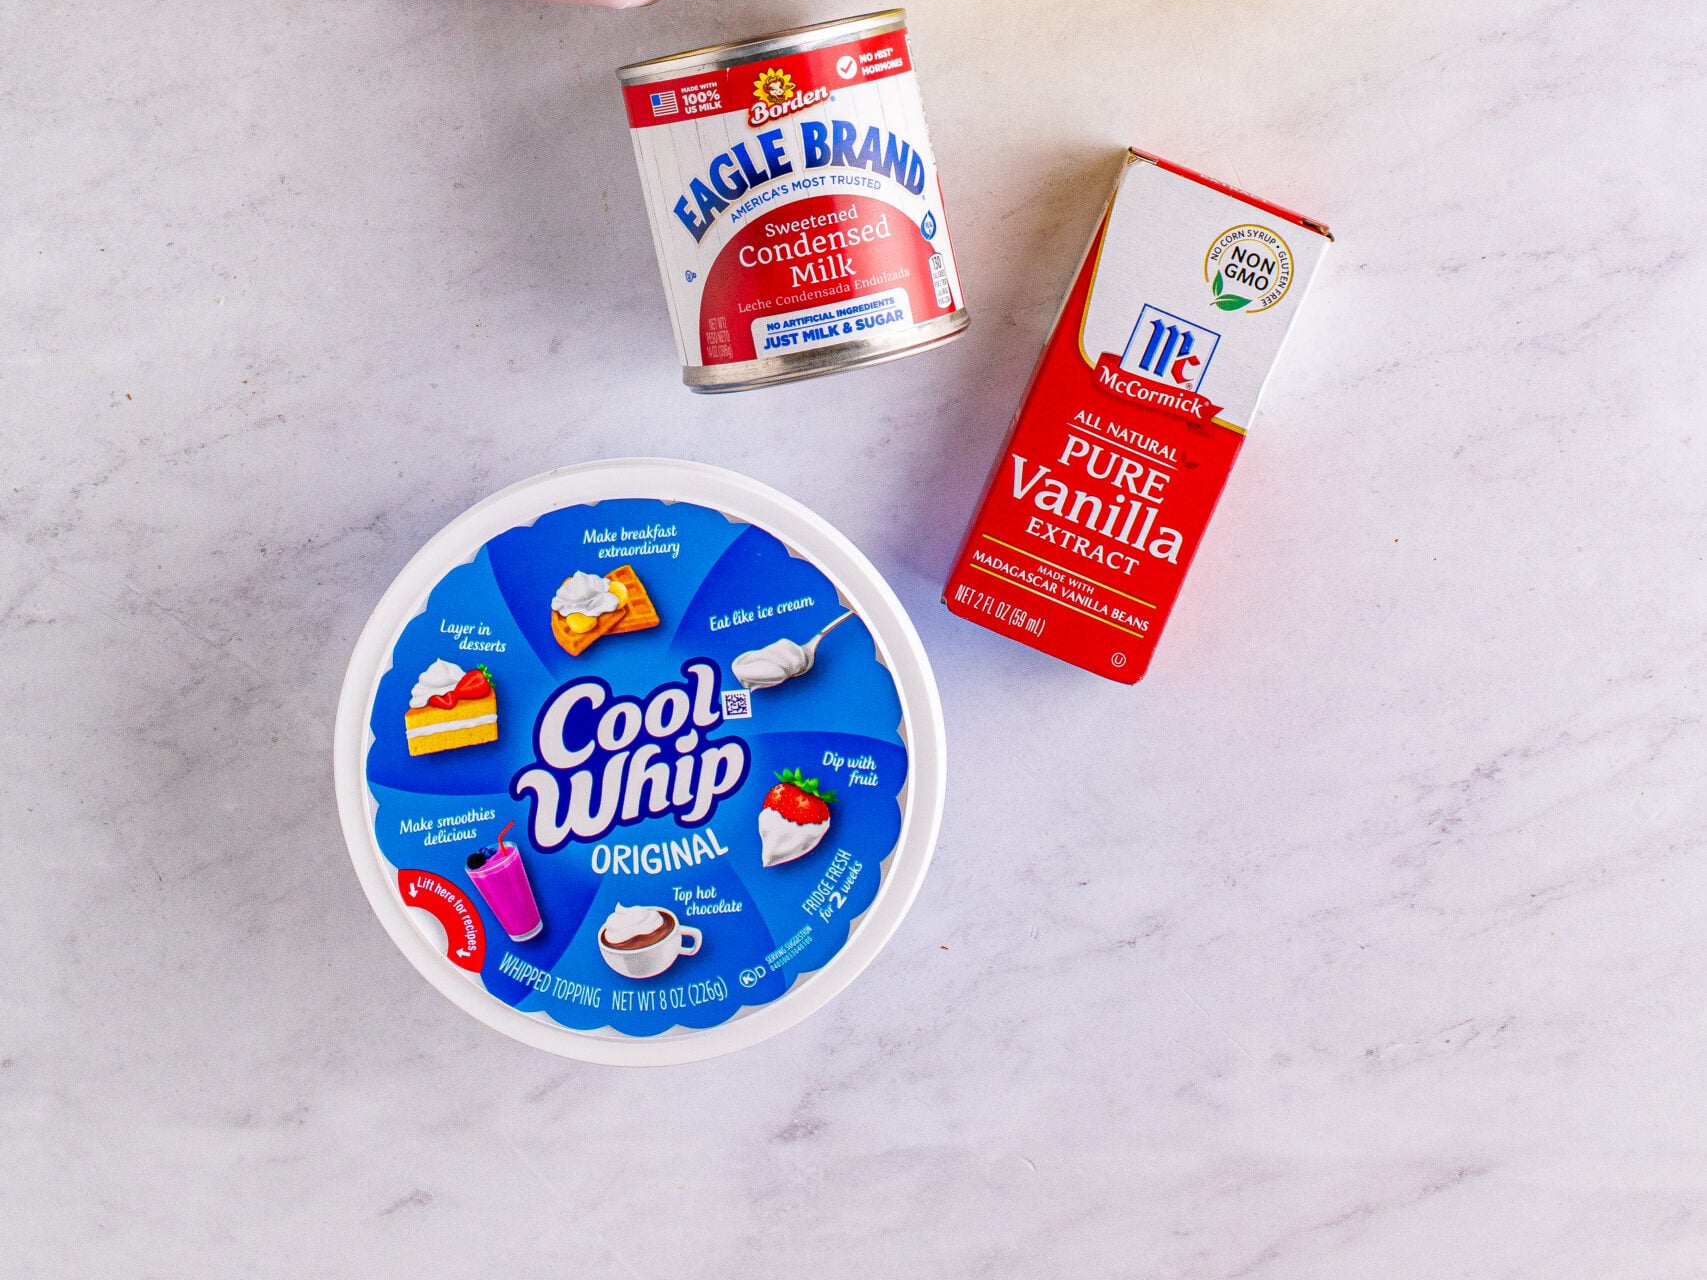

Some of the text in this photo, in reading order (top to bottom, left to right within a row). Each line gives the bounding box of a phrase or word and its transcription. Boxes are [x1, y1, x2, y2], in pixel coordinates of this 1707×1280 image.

[862, 58, 903, 75] HORMONES
[681, 81, 718, 93] MADE WITH
[682, 89, 720, 105] 100%
[685, 100, 722, 115] US MILK
[750, 86, 829, 125] Borden
[800, 119, 926, 195] BRAND
[673, 128, 793, 244] EAGLE
[792, 175, 881, 191] MOST TRUSTED
[730, 185, 790, 223] AMERICA'S
[764, 204, 858, 238] Sweetened
[738, 214, 892, 268] Condensed
[790, 253, 856, 288] Milk
[1210, 229, 1289, 306] NO CORN SYRUP GLUTEN FREE
[1224, 263, 1269, 291] GMO
[1230, 246, 1275, 275] NON
[738, 298, 772, 314] Leche
[776, 282, 850, 308] Condensada
[854, 266, 910, 290] Endulzada
[764, 309, 904, 350] JUST MILK & SUGAR
[766, 296, 895, 332] NO ARTIFICIAL INGREDIENTS
[1099, 365, 1203, 419] McCormick
[1073, 409, 1178, 463] ALL NATURAL
[1057, 434, 1171, 504] PURE
[1011, 453, 1184, 565] Vanilla
[583, 524, 677, 544] Make breakfast
[598, 542, 681, 559] extraordinary
[1026, 517, 1140, 576] EXTRACT
[973, 550, 1149, 632] MADAGASCAR VANILLA BEANS
[1037, 565, 1095, 594] MADE WITH
[709, 596, 814, 632] Eat like ice cream
[955, 584, 1046, 637] NET 2 FL OZ (59 mL)
[440, 619, 492, 642] Layer in
[459, 638, 506, 652] desserts
[539, 664, 720, 769] Cool
[822, 751, 877, 771] Dip with
[848, 770, 878, 788] fruit
[516, 729, 744, 847] Whip
[400, 809, 496, 835] Make smoothies
[424, 828, 477, 847] delicious
[591, 828, 729, 875] ORIGINAL
[672, 886, 717, 905] Top hot
[802, 848, 852, 916] FRIDGE FRESH
[818, 860, 864, 924] for 2 weeks
[417, 876, 477, 952] Lift here for recipes
[686, 900, 742, 916] chocolate
[498, 952, 602, 1008] WHIPPED TOPPING
[612, 976, 728, 1012] NET WT 8 OZ (226g)
